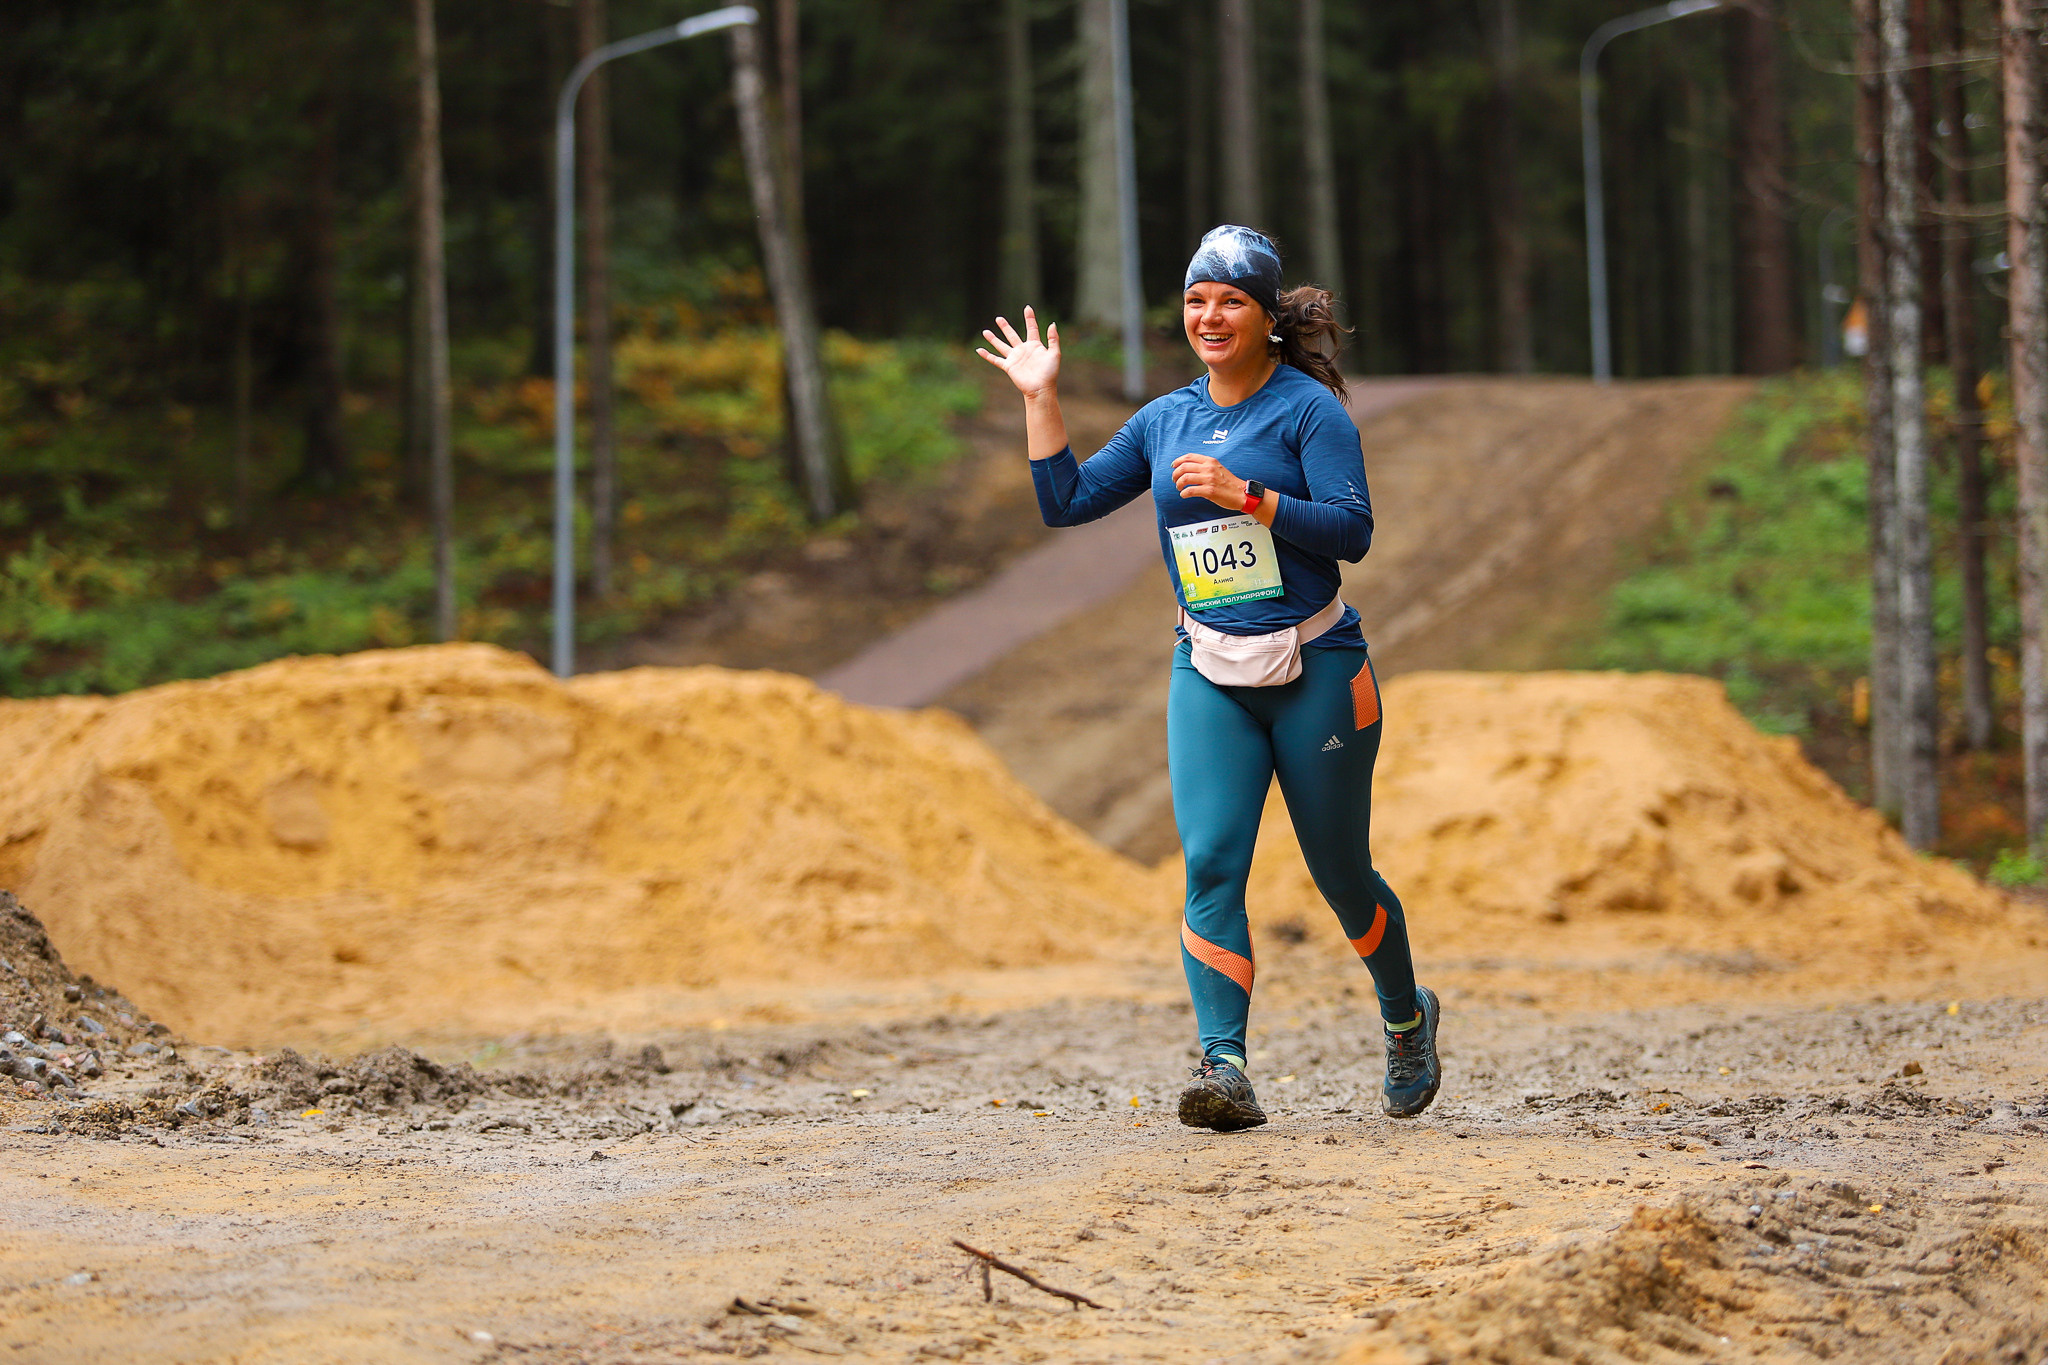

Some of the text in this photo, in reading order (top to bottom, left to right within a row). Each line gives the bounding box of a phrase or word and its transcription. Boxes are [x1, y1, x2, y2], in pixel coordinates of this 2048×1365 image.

[1189, 541, 1257, 577] 1043
[1213, 576, 1234, 585] Алина
[1186, 583, 1196, 591] 18
[1221, 589, 1276, 604] ПОЛУМАРАФОН
[1321, 742, 1344, 752] adidas
